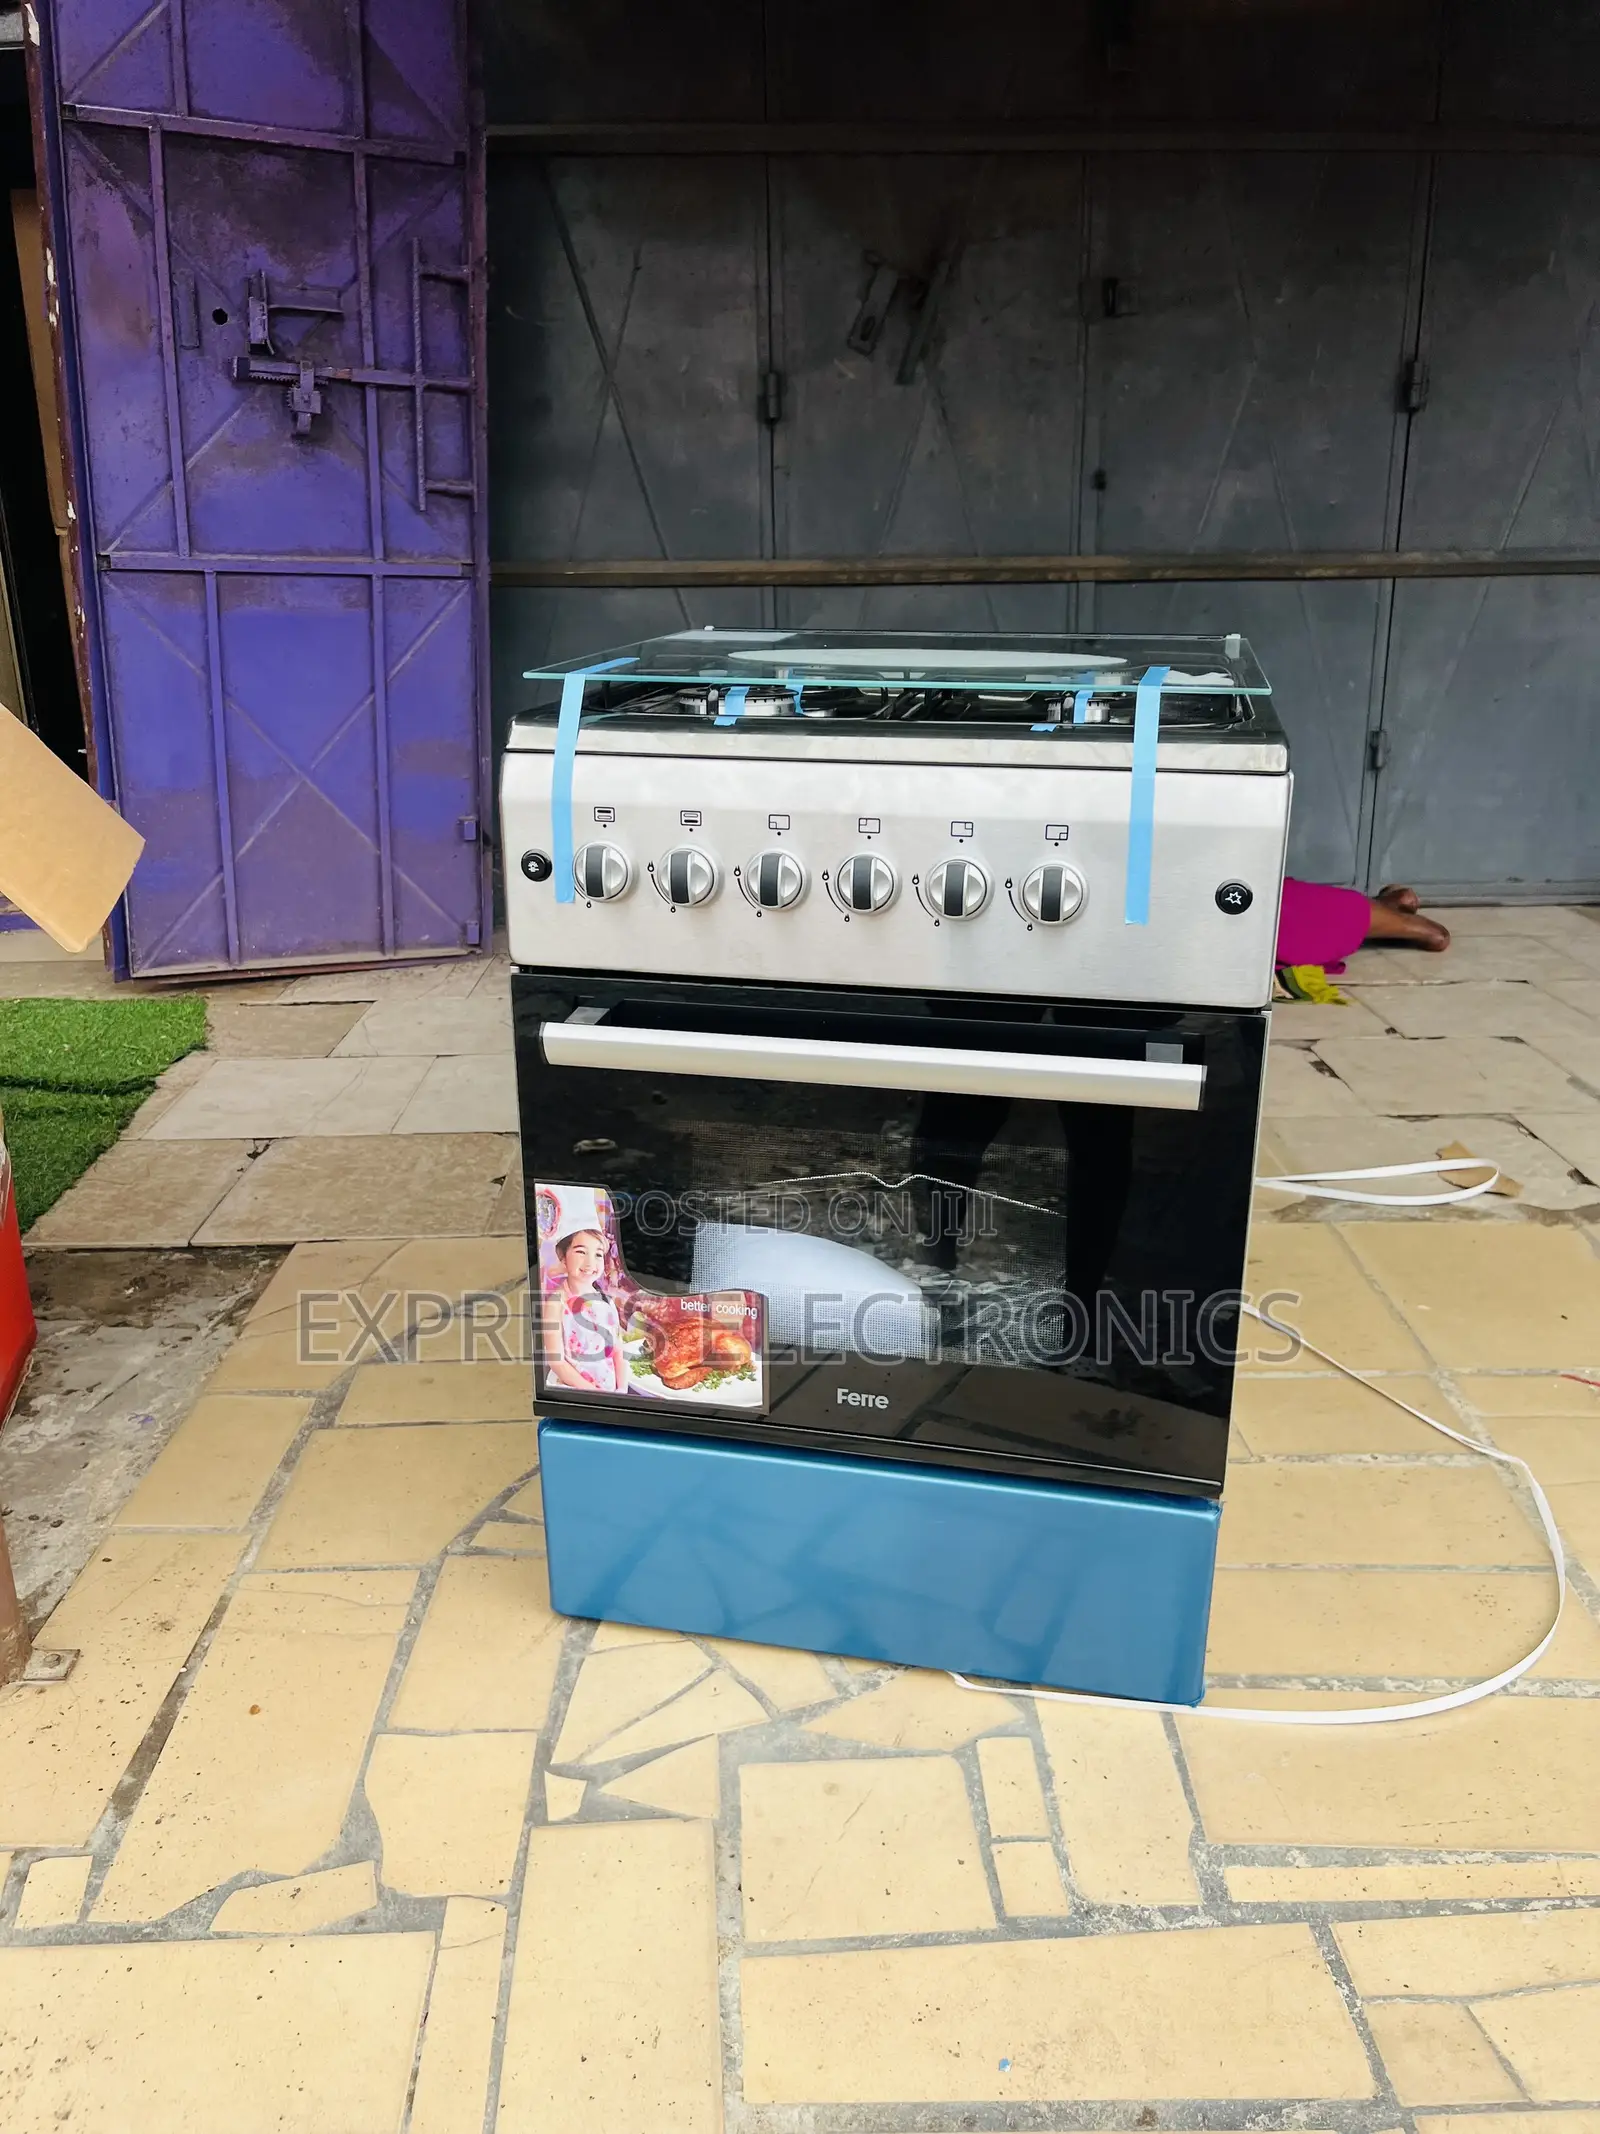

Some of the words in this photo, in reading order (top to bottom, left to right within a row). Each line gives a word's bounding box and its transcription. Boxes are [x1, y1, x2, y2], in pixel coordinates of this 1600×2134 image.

[680, 1298, 711, 1312] better
[715, 1303, 758, 1320] cooking
[836, 1387, 889, 1409] Ferre
